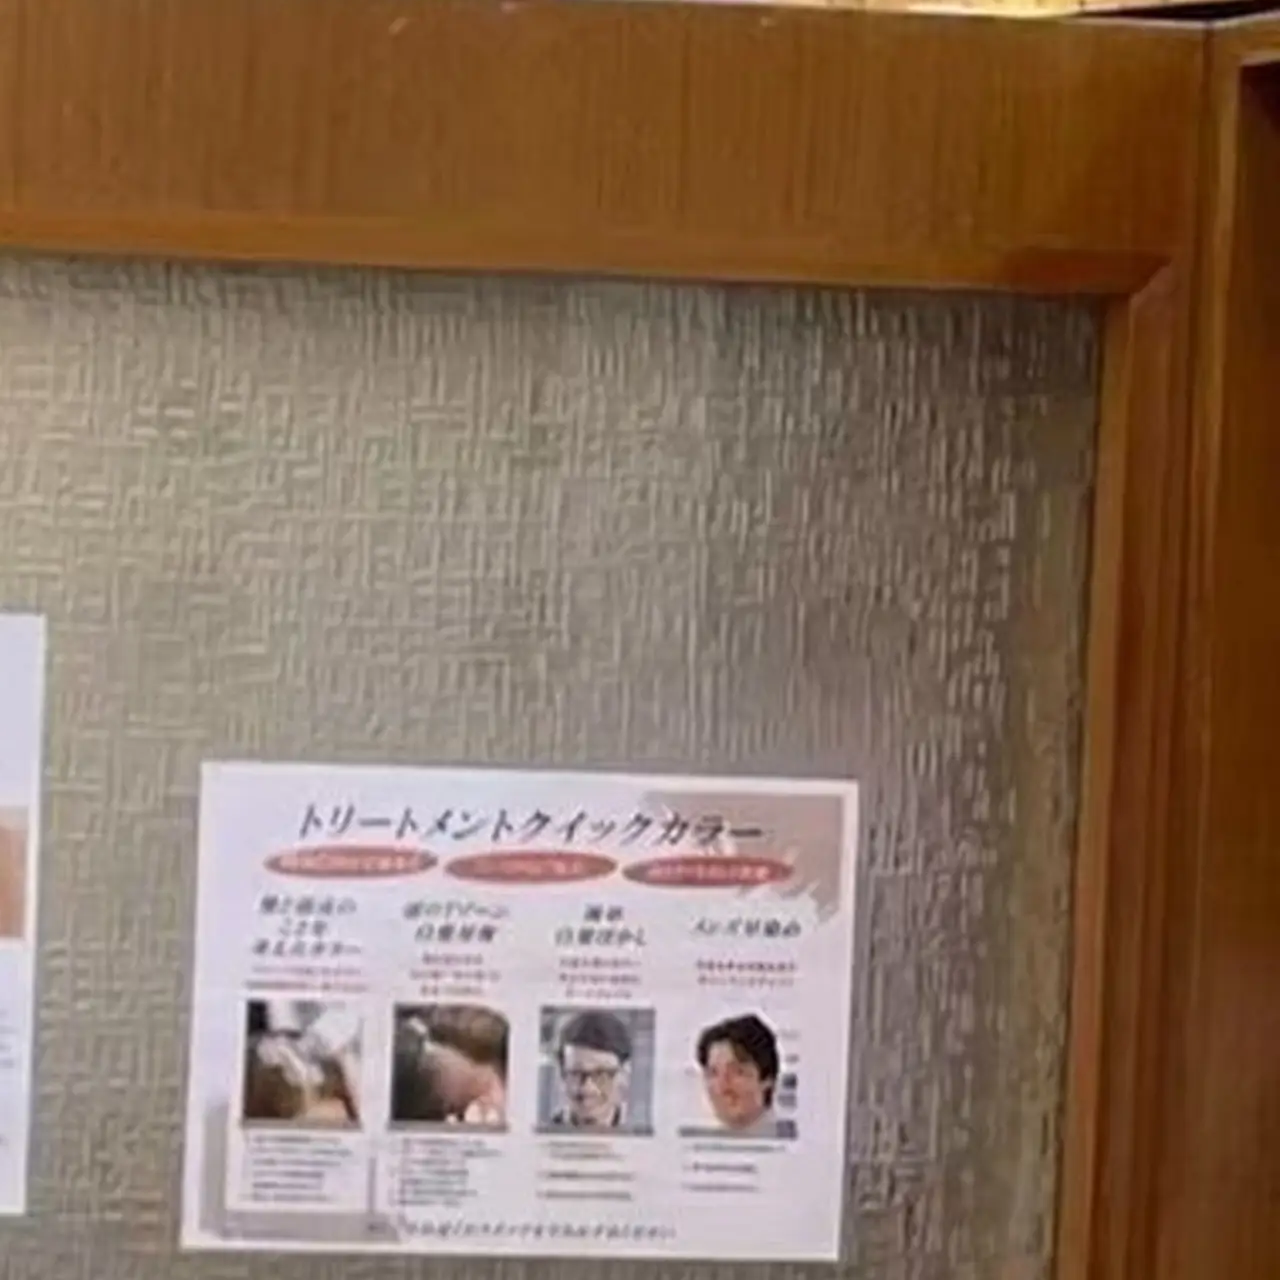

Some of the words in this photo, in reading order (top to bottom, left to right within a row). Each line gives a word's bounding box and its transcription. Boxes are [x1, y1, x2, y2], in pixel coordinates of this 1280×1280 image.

[297, 803, 763, 846] トリートメントクイックカラー
